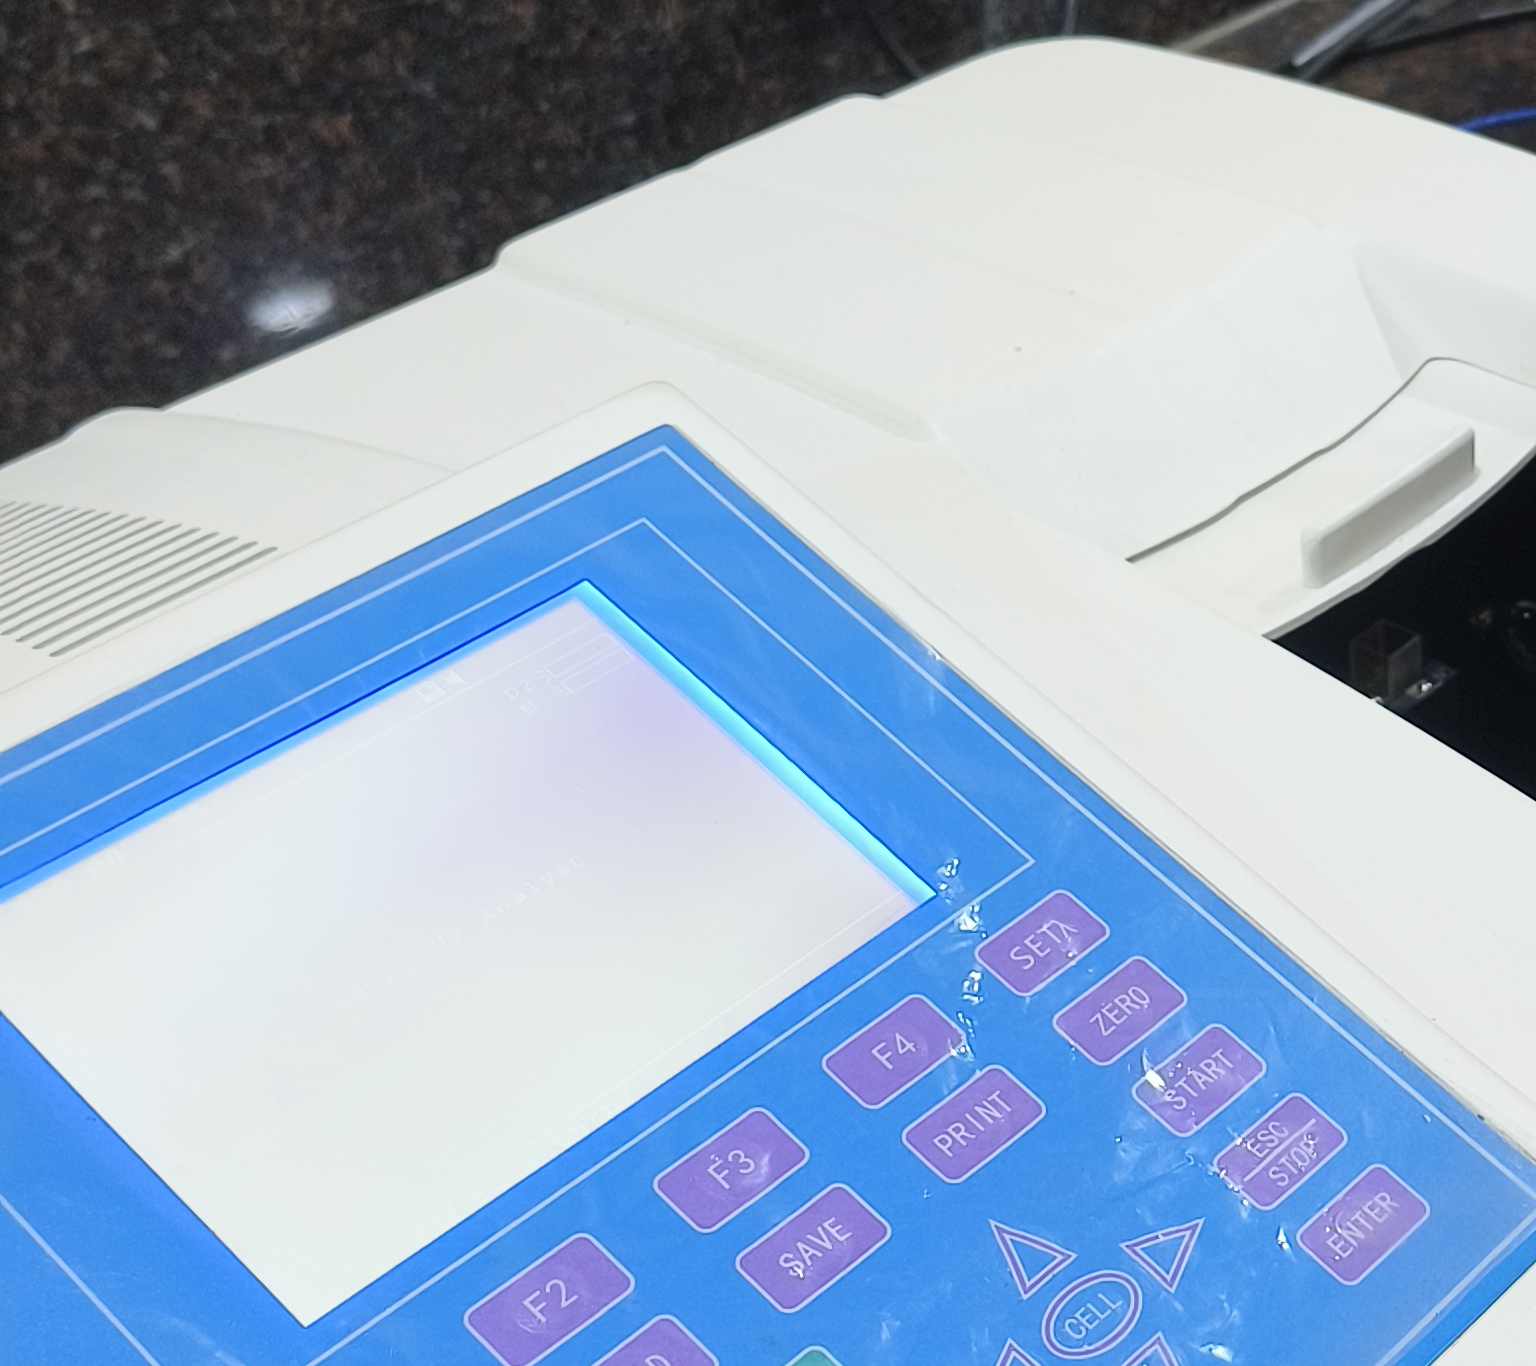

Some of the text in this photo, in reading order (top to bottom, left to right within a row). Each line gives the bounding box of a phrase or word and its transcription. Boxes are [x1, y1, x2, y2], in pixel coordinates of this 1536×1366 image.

[1088, 985, 1151, 1036] ZERO
[871, 1032, 917, 1070] F4
[1163, 1048, 1235, 1111] START
[932, 1090, 1012, 1157] PRINT
[1246, 1121, 1289, 1159] ESC
[706, 1149, 755, 1191] F3
[779, 1217, 853, 1277] SAVE
[1325, 1191, 1400, 1259] ENTER
[522, 1278, 579, 1323] F2
[1063, 1292, 1124, 1340] CELL
